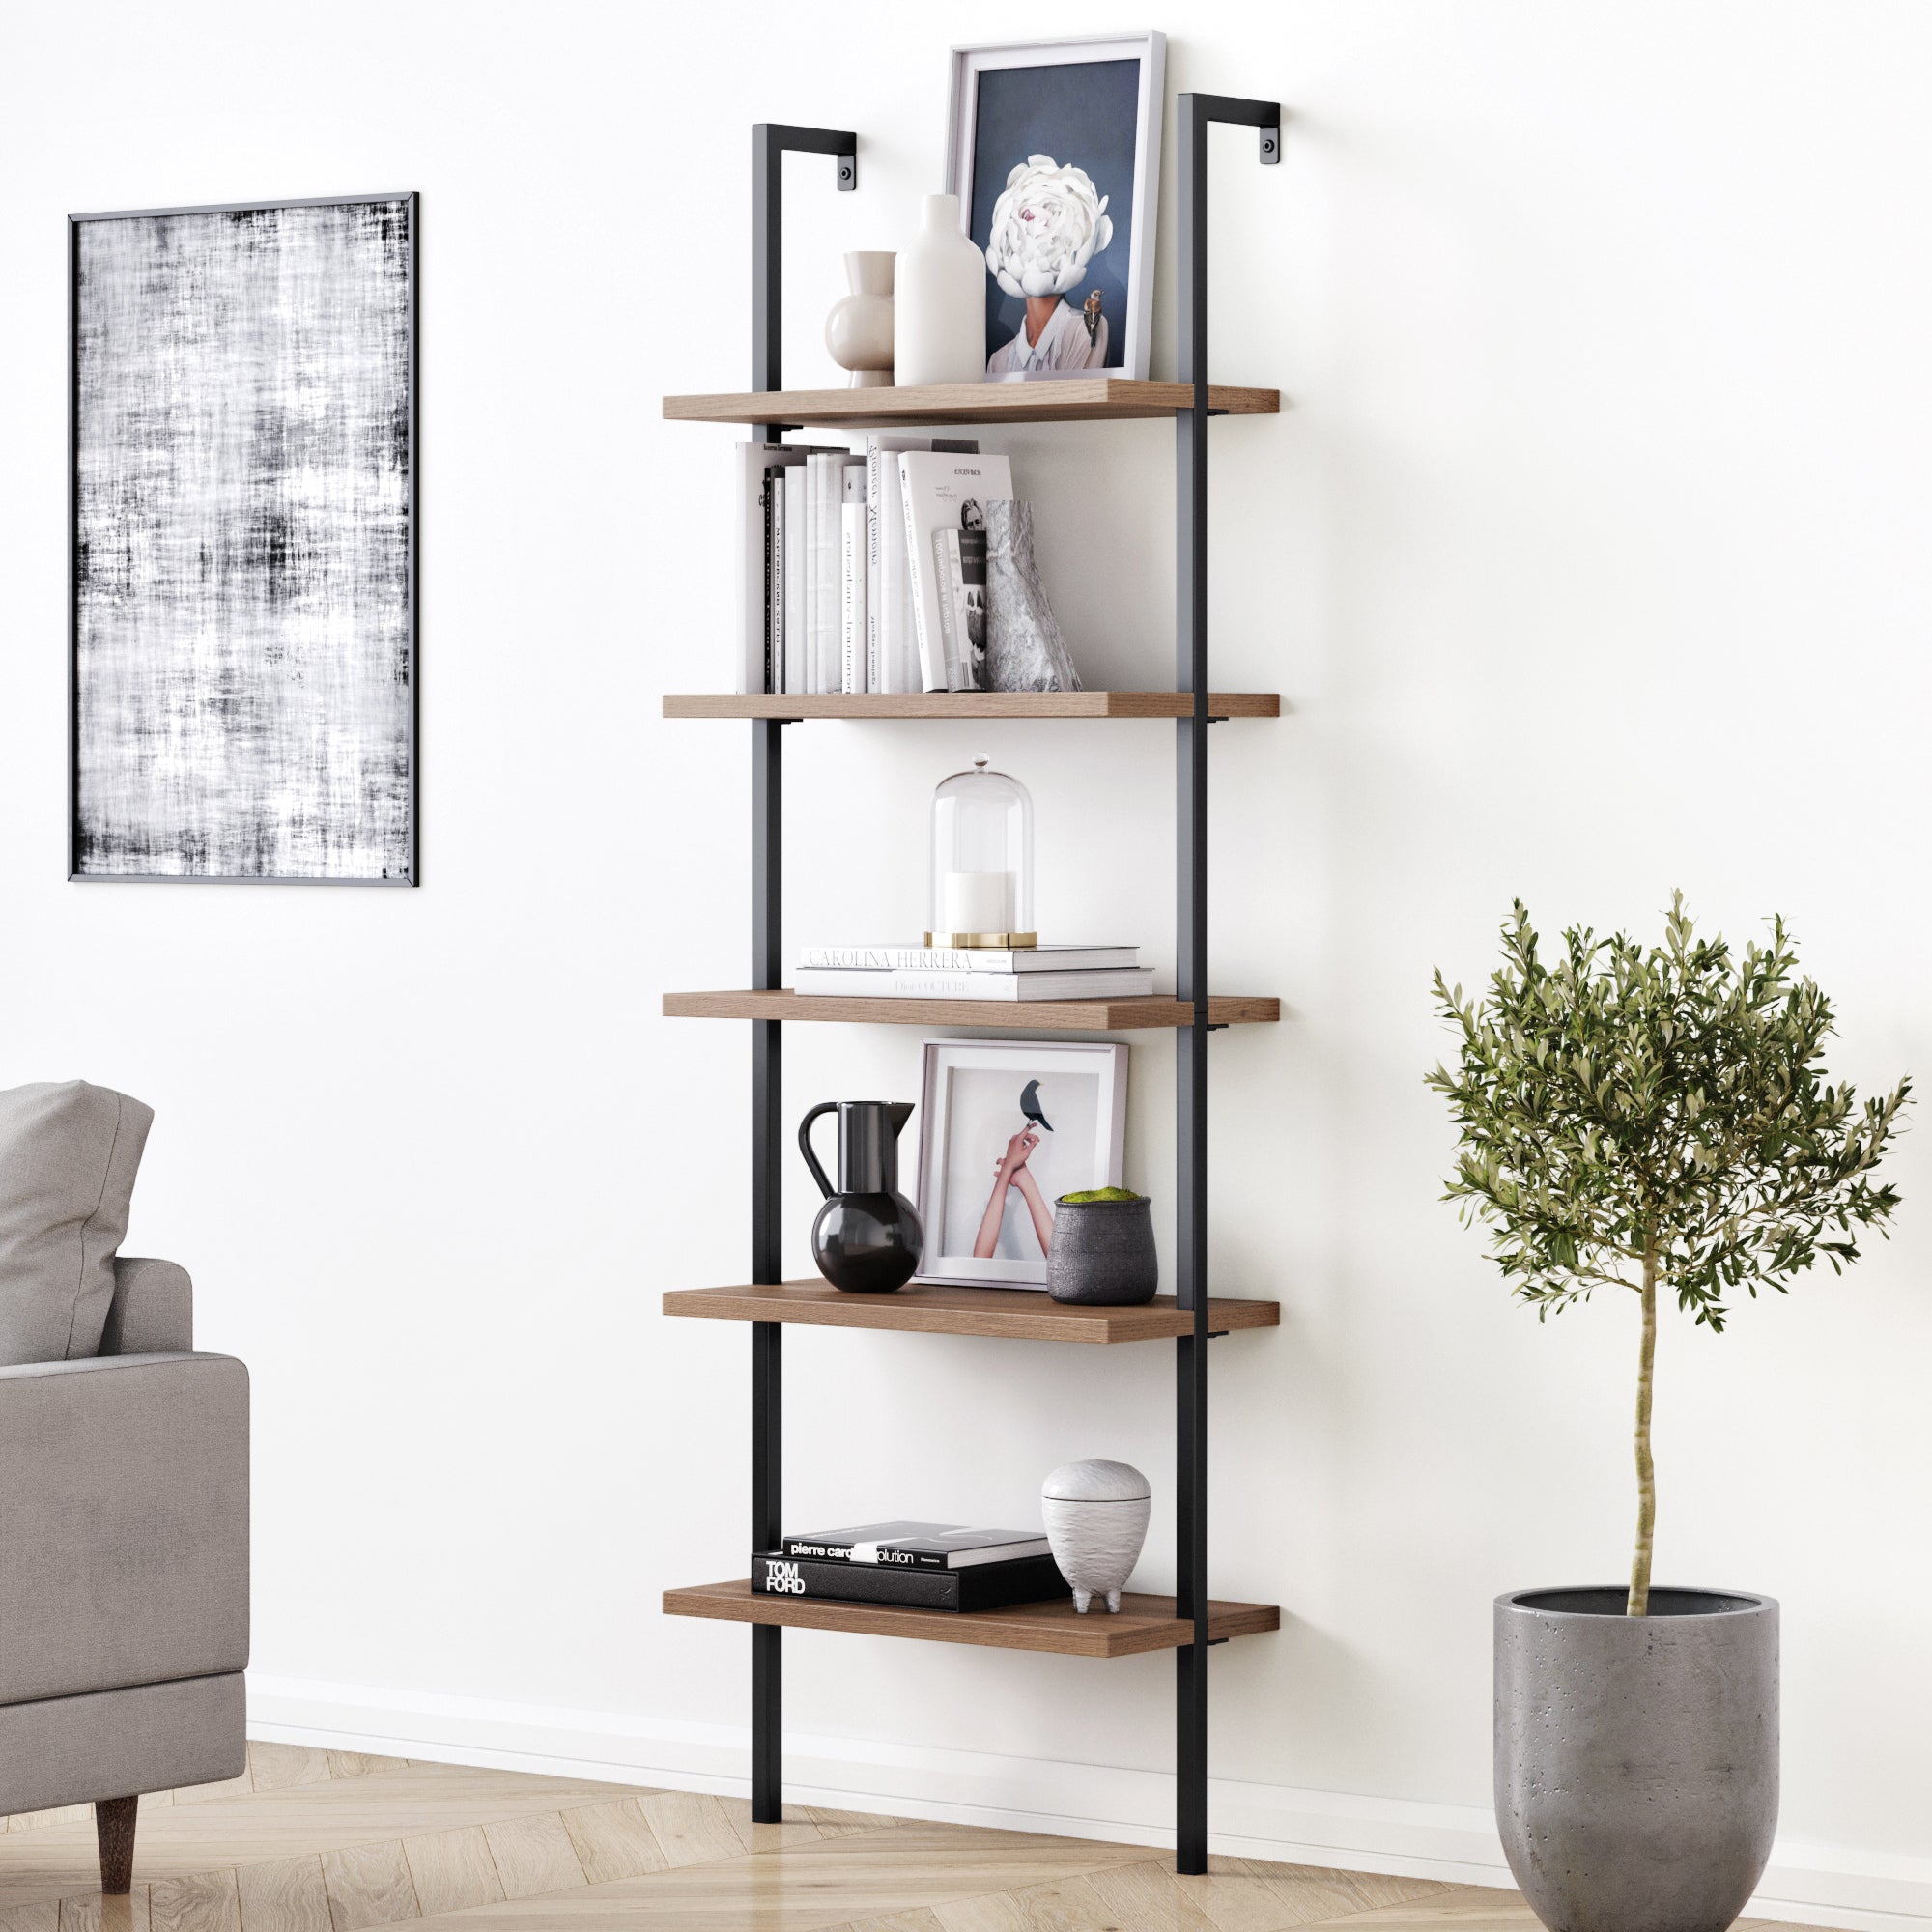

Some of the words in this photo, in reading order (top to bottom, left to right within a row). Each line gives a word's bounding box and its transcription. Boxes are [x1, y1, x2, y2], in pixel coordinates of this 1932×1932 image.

[809, 950, 891, 967] CAROLINA
[896, 951, 973, 969] HERRERA
[790, 1543, 825, 1556] pierre
[827, 1547, 857, 1560] card
[877, 1548, 914, 1564] olution
[766, 1561, 799, 1578] TOM
[766, 1577, 806, 1595] FORD
